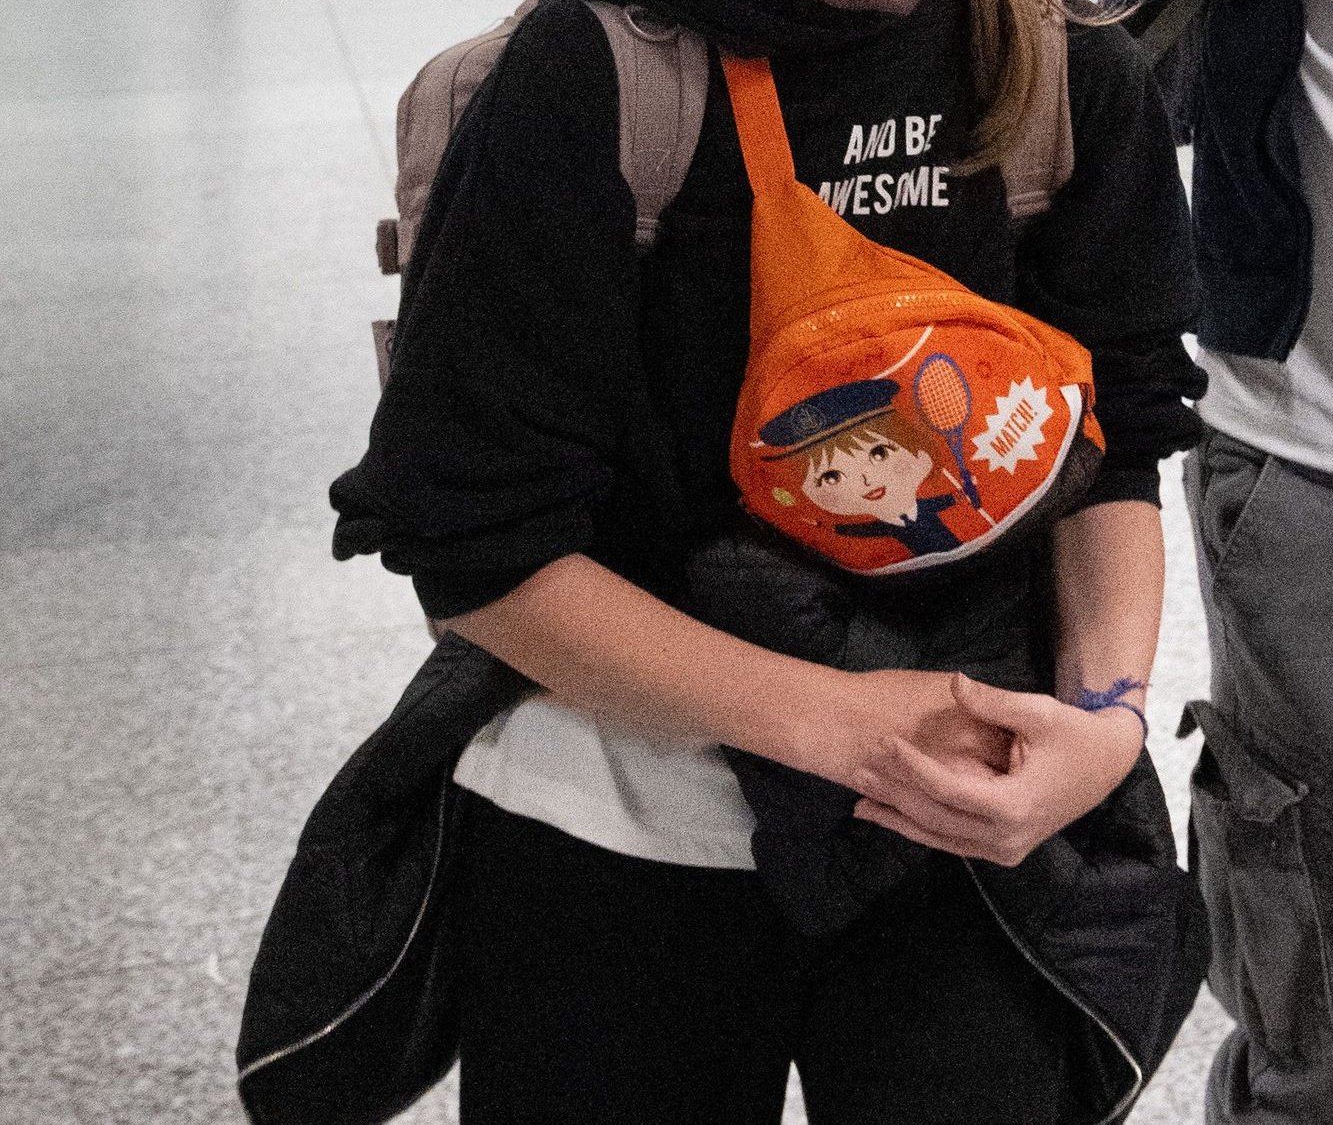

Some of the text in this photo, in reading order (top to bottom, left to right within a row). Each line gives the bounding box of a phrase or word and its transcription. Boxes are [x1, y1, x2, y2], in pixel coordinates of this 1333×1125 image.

[844, 114, 943, 166] AND BE
[815, 166, 950, 216] AWESOME
[989, 398, 1039, 459] MATCH!
